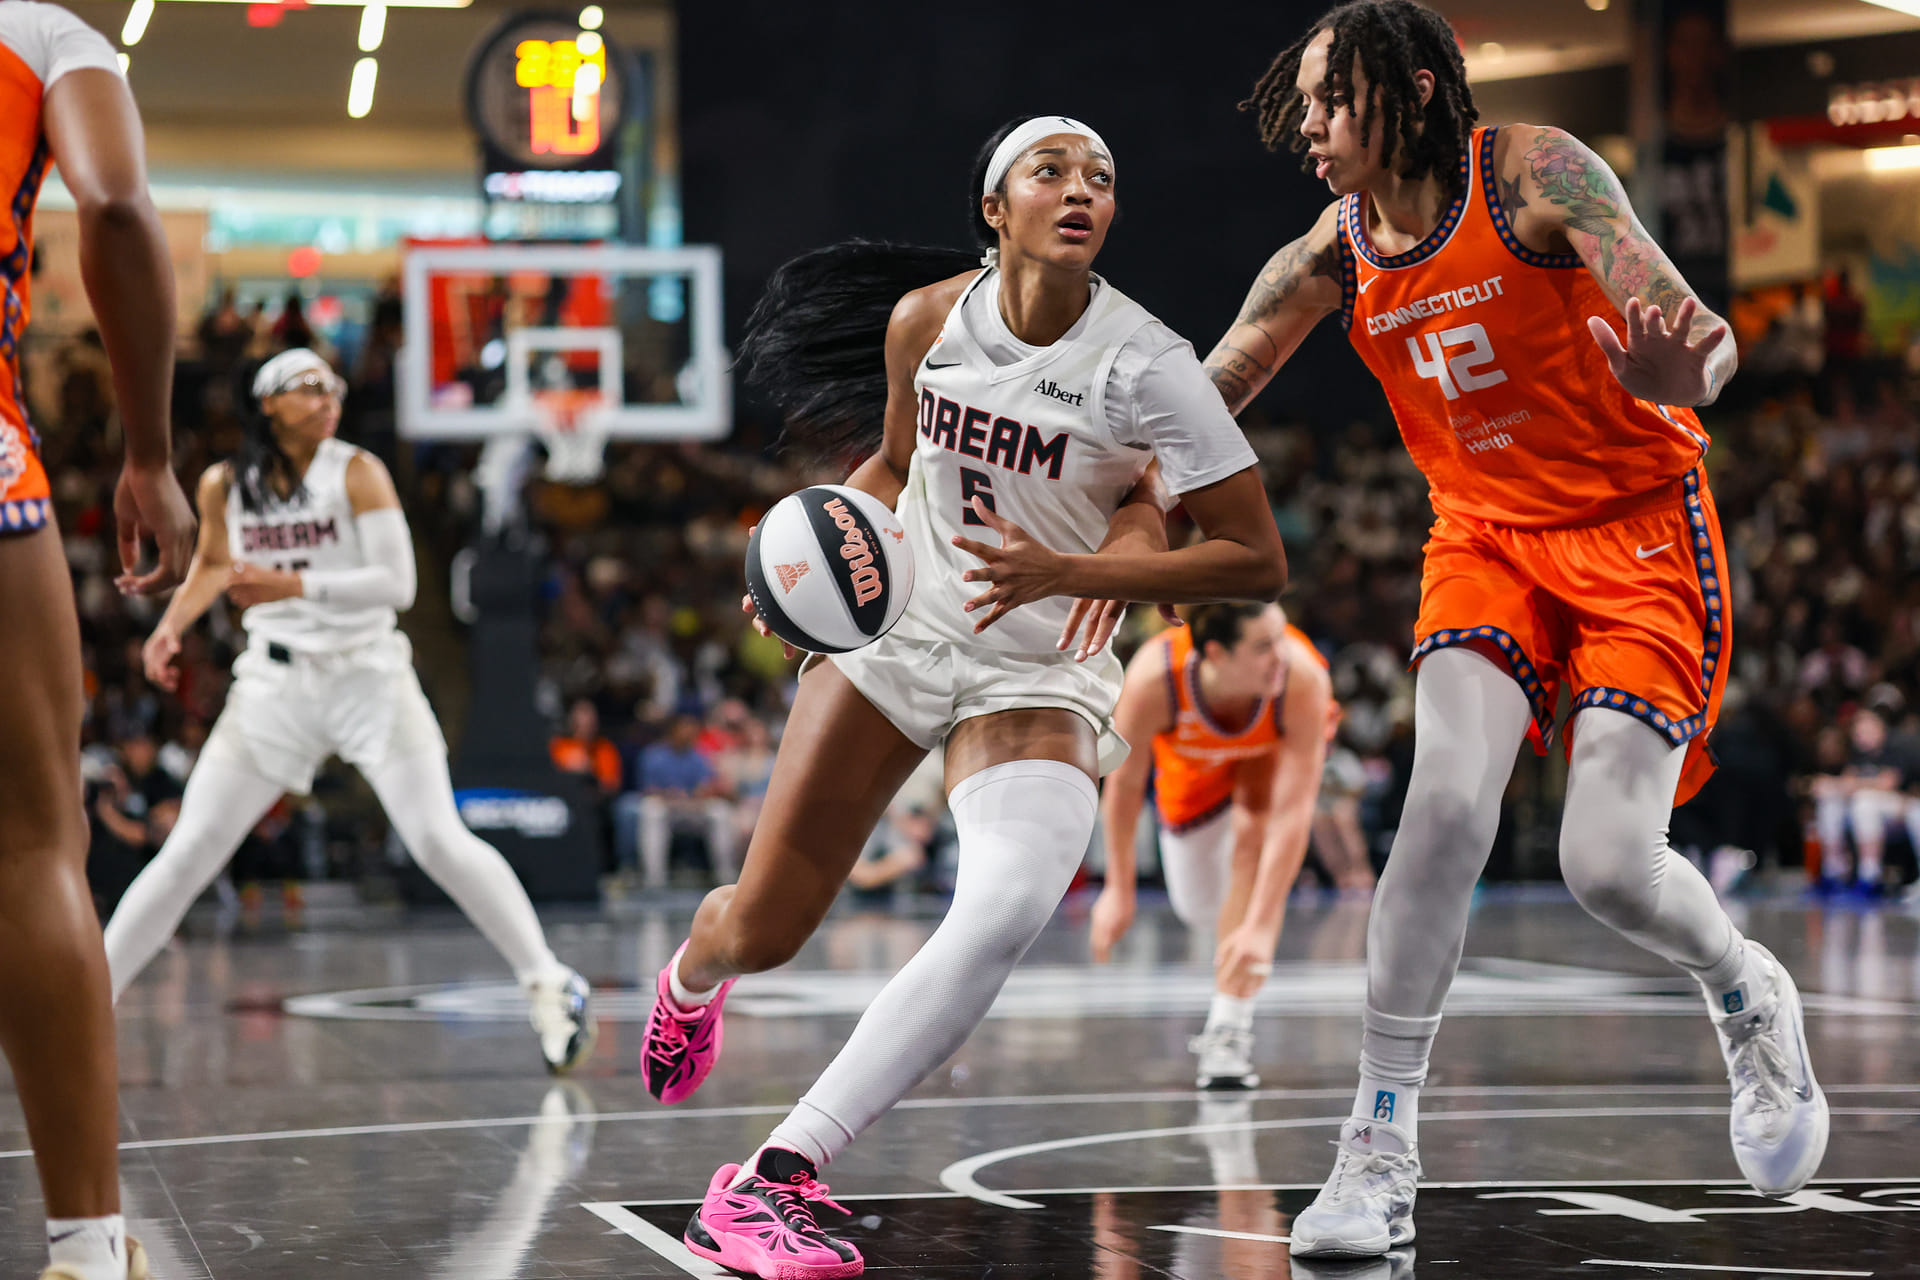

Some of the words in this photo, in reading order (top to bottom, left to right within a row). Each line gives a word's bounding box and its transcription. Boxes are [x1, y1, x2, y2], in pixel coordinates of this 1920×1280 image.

[1366, 275, 1504, 336] CONNECTICUT
[1405, 322, 1509, 401] 42
[1034, 378, 1084, 407] Albert
[1482, 409, 1531, 435] Haven
[920, 384, 1070, 481] DREAM
[960, 466, 997, 527] 5
[242, 518, 339, 551] DREAM
[823, 497, 883, 608] Wilson
